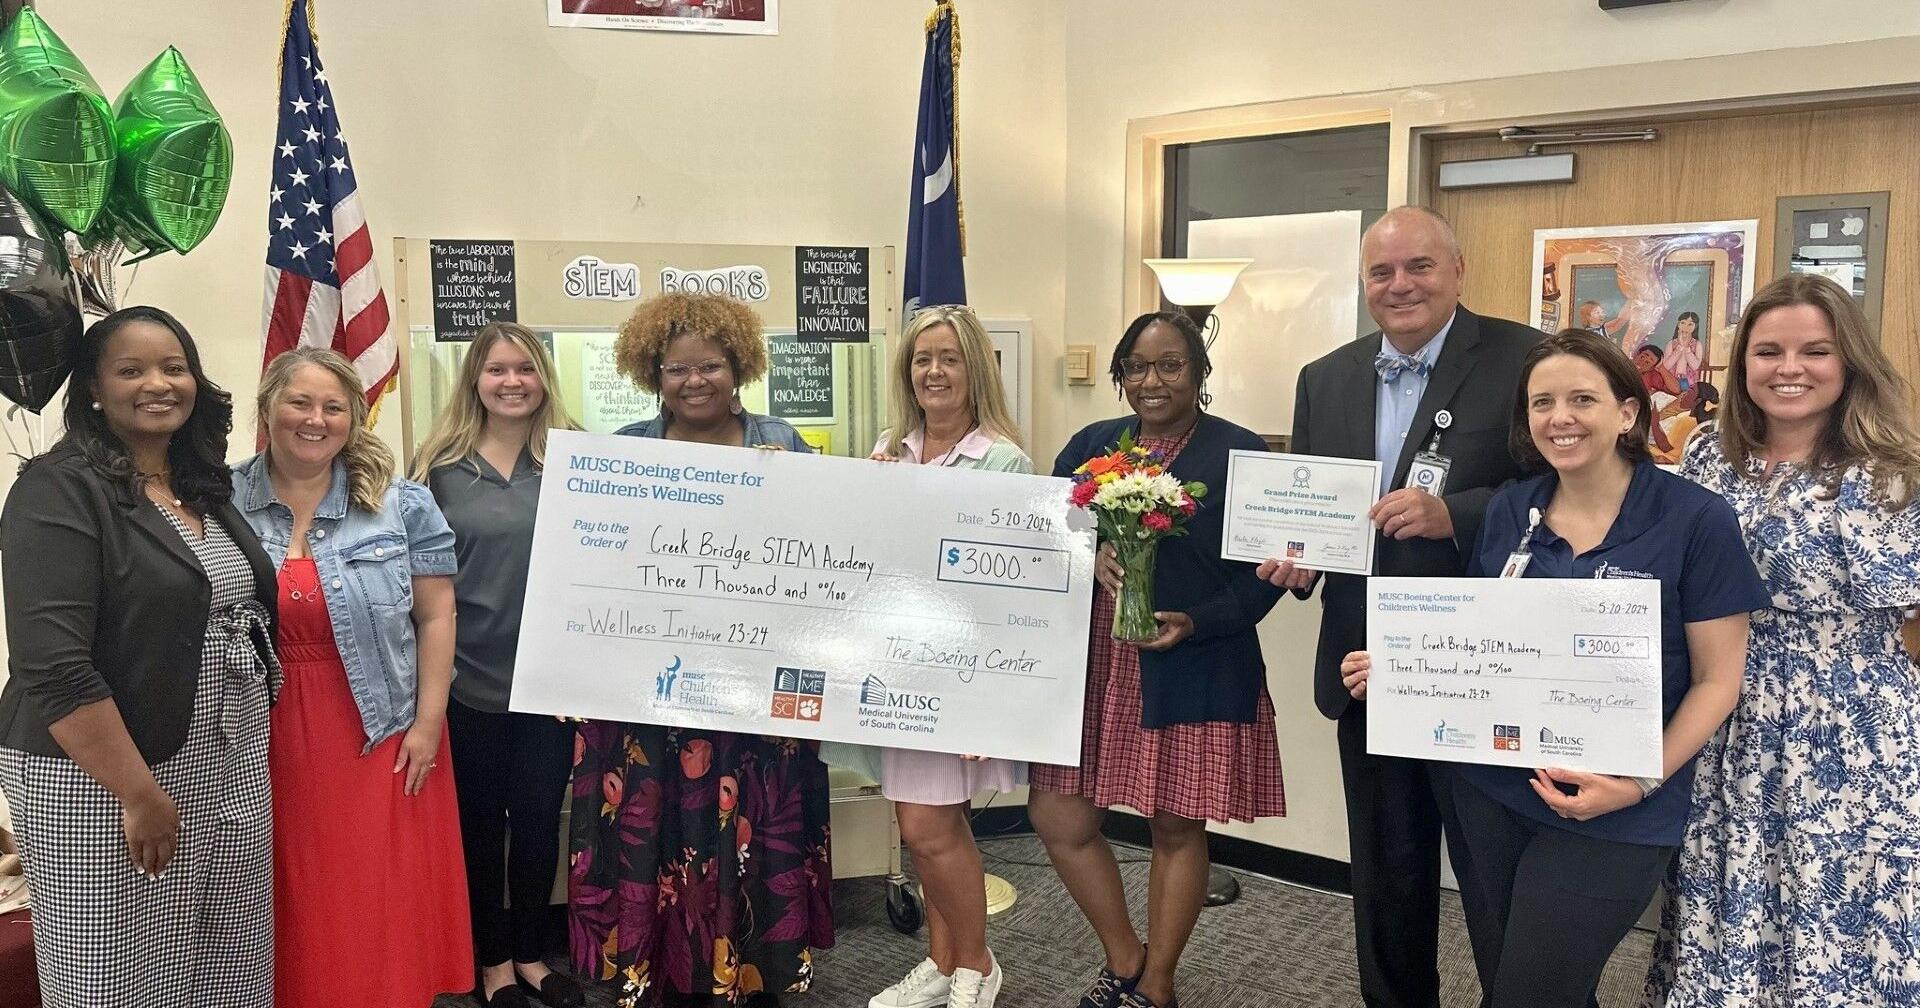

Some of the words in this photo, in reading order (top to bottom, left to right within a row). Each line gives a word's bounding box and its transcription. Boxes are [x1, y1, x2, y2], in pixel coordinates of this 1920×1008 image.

[466, 244, 514, 256] LABORATORY
[820, 249, 847, 261] beauty
[444, 258, 459, 269] the
[803, 261, 862, 275] ENGINEERING
[447, 271, 476, 284] where
[476, 271, 513, 284] behind
[565, 259, 636, 298] STEM
[661, 271, 767, 300] BOOKS
[438, 284, 485, 298] ILLUSIONS
[487, 290, 500, 298] we
[802, 286, 868, 305] FAILURE
[816, 304, 840, 316] leads
[799, 316, 868, 332] INNOVATION.
[772, 363, 830, 380] important
[570, 455, 621, 474] MUSC
[623, 460, 680, 482] Boeing
[683, 466, 739, 486] Center
[739, 470, 764, 487] for
[567, 477, 648, 498] Children's
[651, 485, 724, 506] Wellness
[1264, 488, 1288, 497] Grand
[1289, 491, 1309, 499] Prize
[1310, 493, 1338, 501] Award
[957, 511, 984, 526] Date
[1245, 503, 1268, 512] Creek
[1268, 506, 1294, 515] Bridge
[1294, 508, 1317, 517] STEM
[1318, 510, 1356, 521] Academy
[572, 519, 595, 534] Pay
[597, 521, 609, 532] to
[610, 522, 629, 535] the
[580, 535, 614, 550] Order
[615, 539, 628, 551] of
[650, 524, 688, 556] Creek
[699, 531, 751, 570] Bridge
[762, 536, 816, 569] STEM
[823, 545, 874, 582] Academy
[637, 564, 686, 589] Three
[693, 564, 777, 597] Thousand
[784, 581, 808, 600] and
[1378, 592, 1403, 601] MUSC
[1404, 592, 1432, 602] Boeing
[1433, 593, 1462, 602] Center
[1462, 594, 1476, 602] for
[1418, 603, 1457, 613] Wellness
[566, 620, 588, 633] For
[587, 607, 657, 635] Wellness
[662, 609, 721, 643] Initiative
[727, 623, 768, 646] 23-24
[1007, 613, 1049, 629] Dollars
[1421, 634, 1446, 650] Creek
[1448, 636, 1477, 657] Bridge
[1480, 639, 1505, 654] STEM
[1508, 641, 1541, 658] Academy
[886, 635, 913, 662] The
[917, 641, 978, 683] Boeing
[985, 648, 1042, 673] Center
[1387, 658, 1412, 672] Three
[1414, 658, 1458, 675] Thousand
[1463, 664, 1482, 675] and
[801, 680, 822, 694] ME
[1397, 684, 1429, 697] Wellness
[1431, 685, 1466, 699] Initiative
[773, 702, 794, 716] SC
[888, 692, 941, 712] MUSC
[1549, 690, 1566, 702] The
[1568, 692, 1601, 713] Boeing
[1605, 694, 1638, 706] Center
[858, 707, 892, 718] Medical
[894, 709, 939, 724] University
[859, 719, 869, 728] of
[870, 720, 896, 731] South
[898, 722, 935, 734] Carolina
[1554, 735, 1584, 745] MUSC
